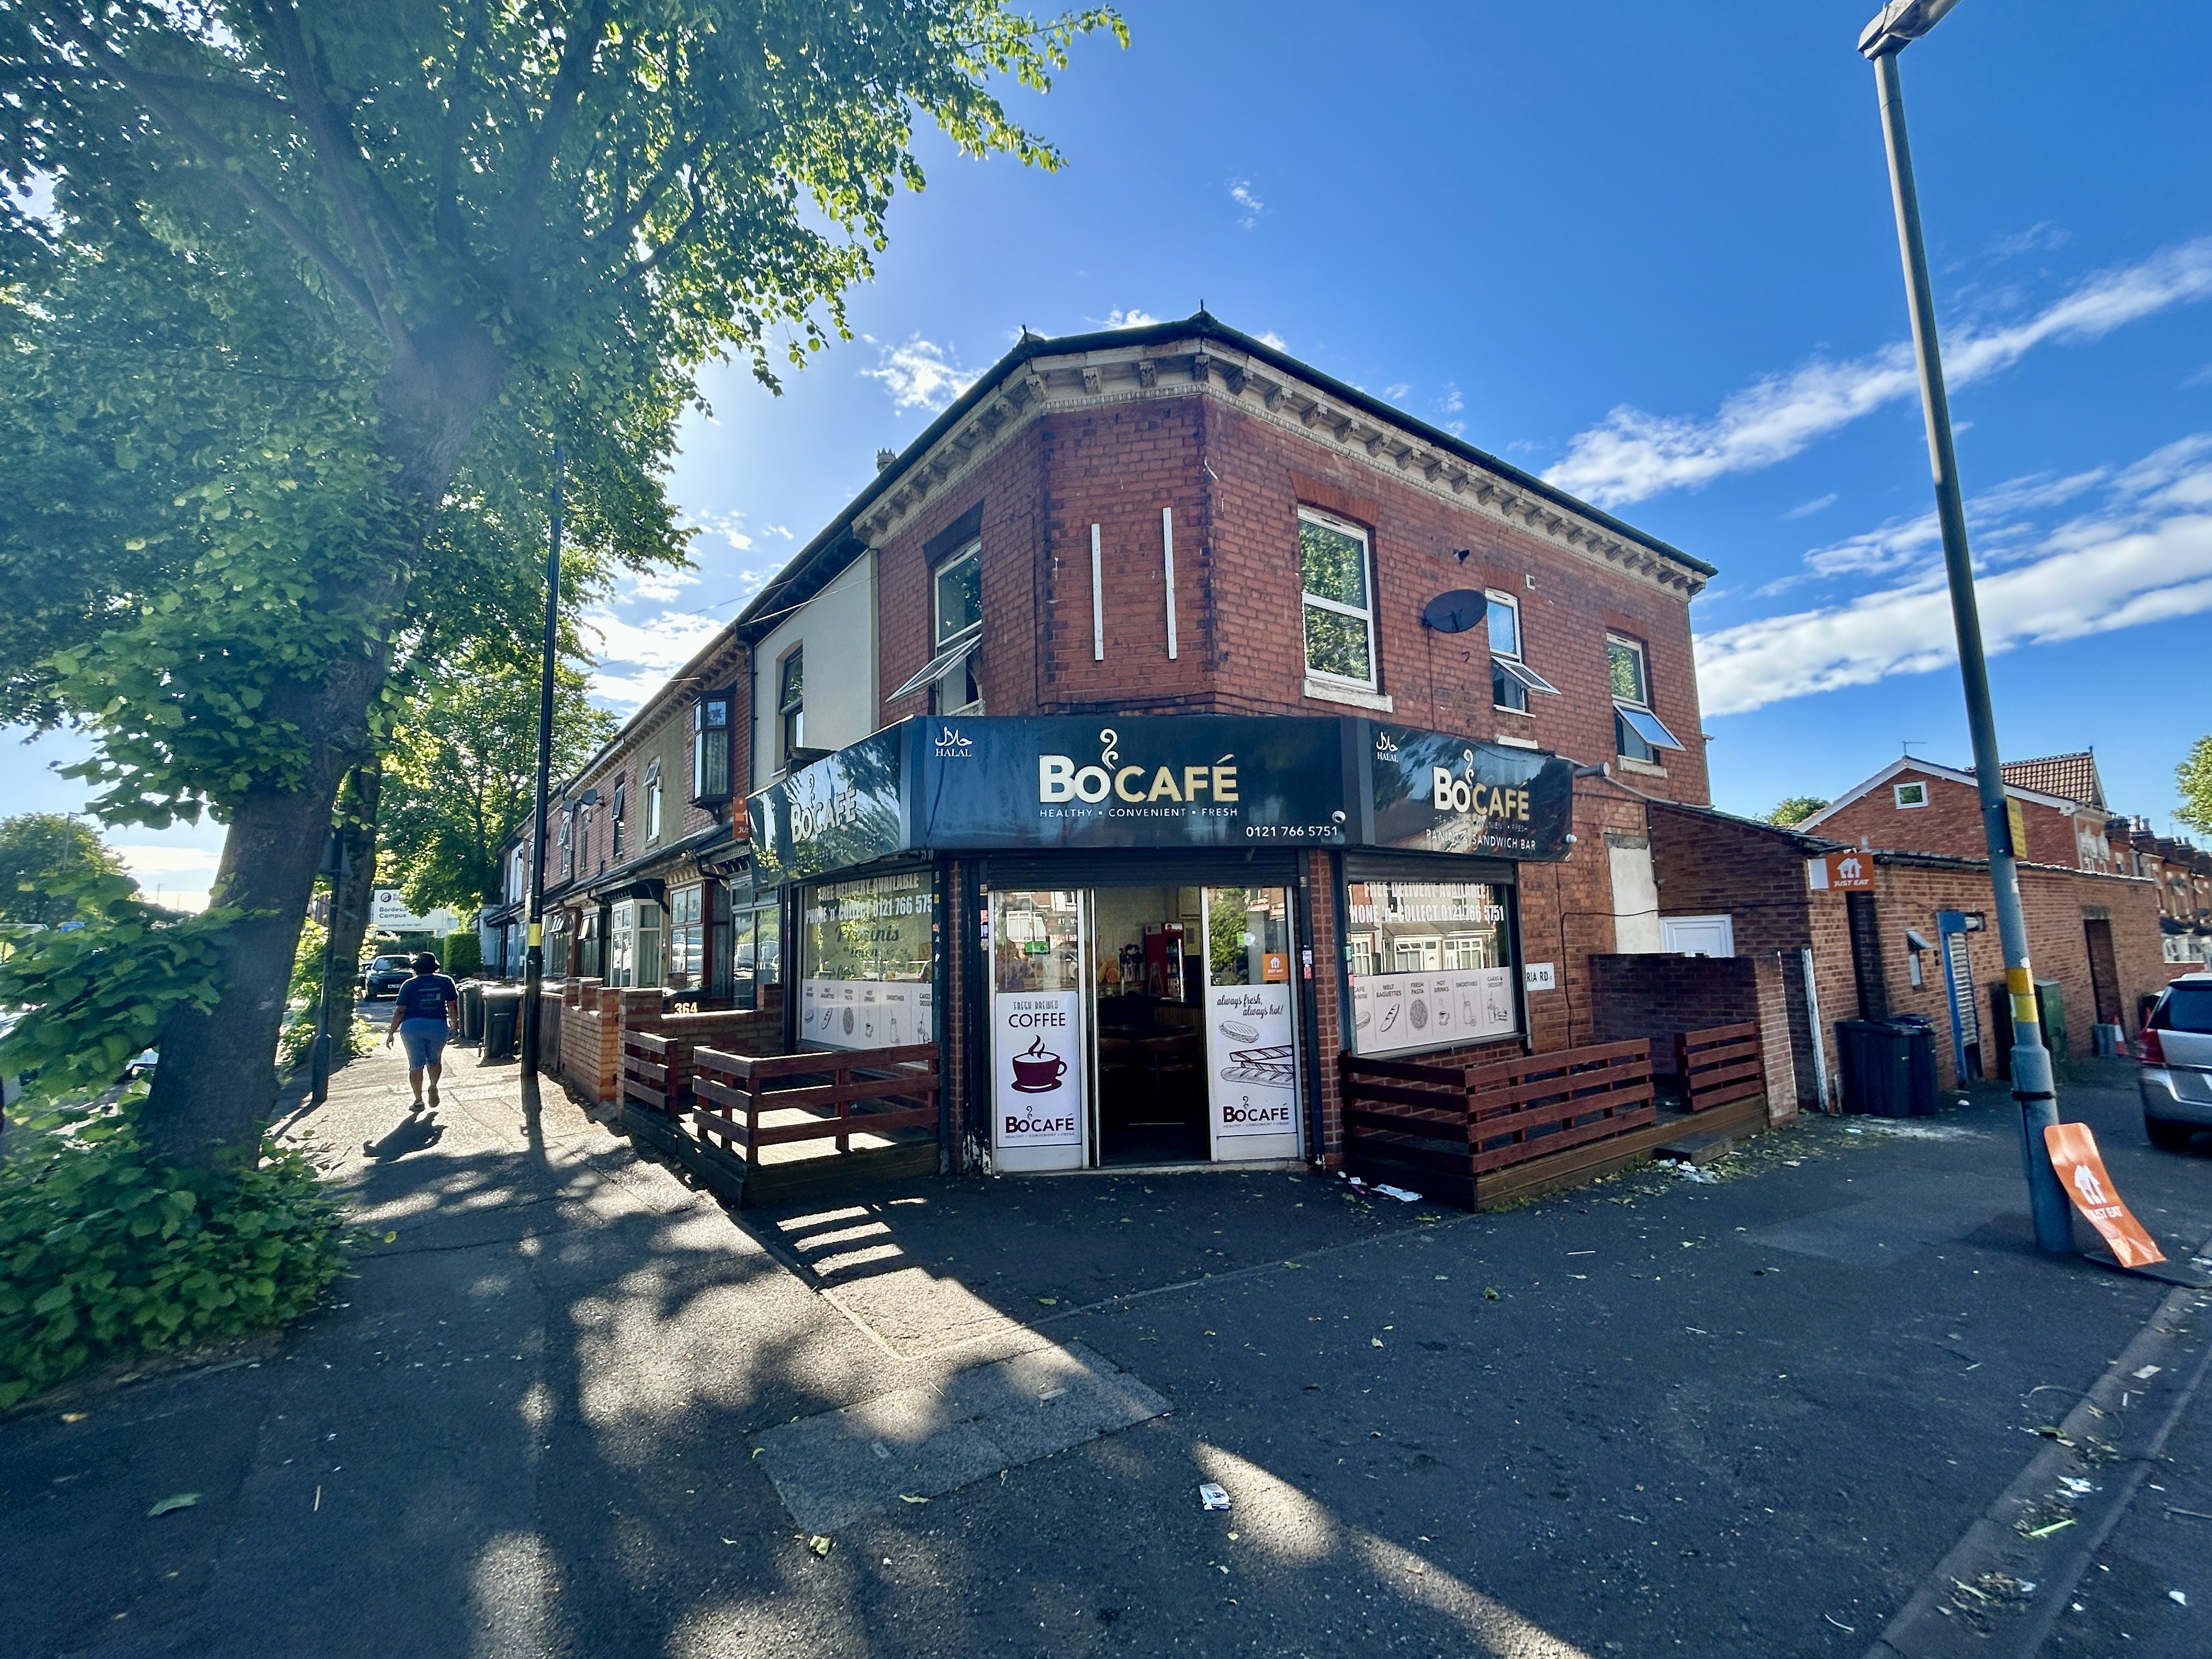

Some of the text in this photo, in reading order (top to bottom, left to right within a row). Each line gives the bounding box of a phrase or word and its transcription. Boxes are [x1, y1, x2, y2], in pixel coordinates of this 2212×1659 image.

[935, 748, 972, 757] HALAL
[1377, 752, 1398, 763] HALAL
[1040, 808, 1238, 817] HEALTHY CONVENIENT FRESH
[1246, 826, 1338, 837] 0121 766 5751
[1472, 834, 1517, 849] SANDWICH
[1520, 839, 1536, 850] BAR
[817, 884, 834, 901] FREE
[873, 873, 919, 894] AVAILABLE
[1363, 881, 1486, 898] FREE DELIVERY AVAILABLE
[806, 906, 827, 924] PHONE
[838, 900, 870, 921] COLLECT
[873, 899, 893, 917] 0121
[895, 896, 913, 915] 766
[915, 894, 933, 914] 575
[1397, 905, 1440, 922] COLLECT
[1441, 905, 1464, 922] 0121
[1465, 905, 1481, 922] 766
[1484, 905, 1504, 922] 5751
[1539, 971, 1548, 981] RD
[674, 1002, 698, 1014] 364
[1014, 1000, 1058, 1010] FRESH BREWED
[1217, 994, 1262, 1008] always fresh,
[1243, 1004, 1284, 1019] always hot!
[1008, 1012, 1065, 1028] COFFEE
